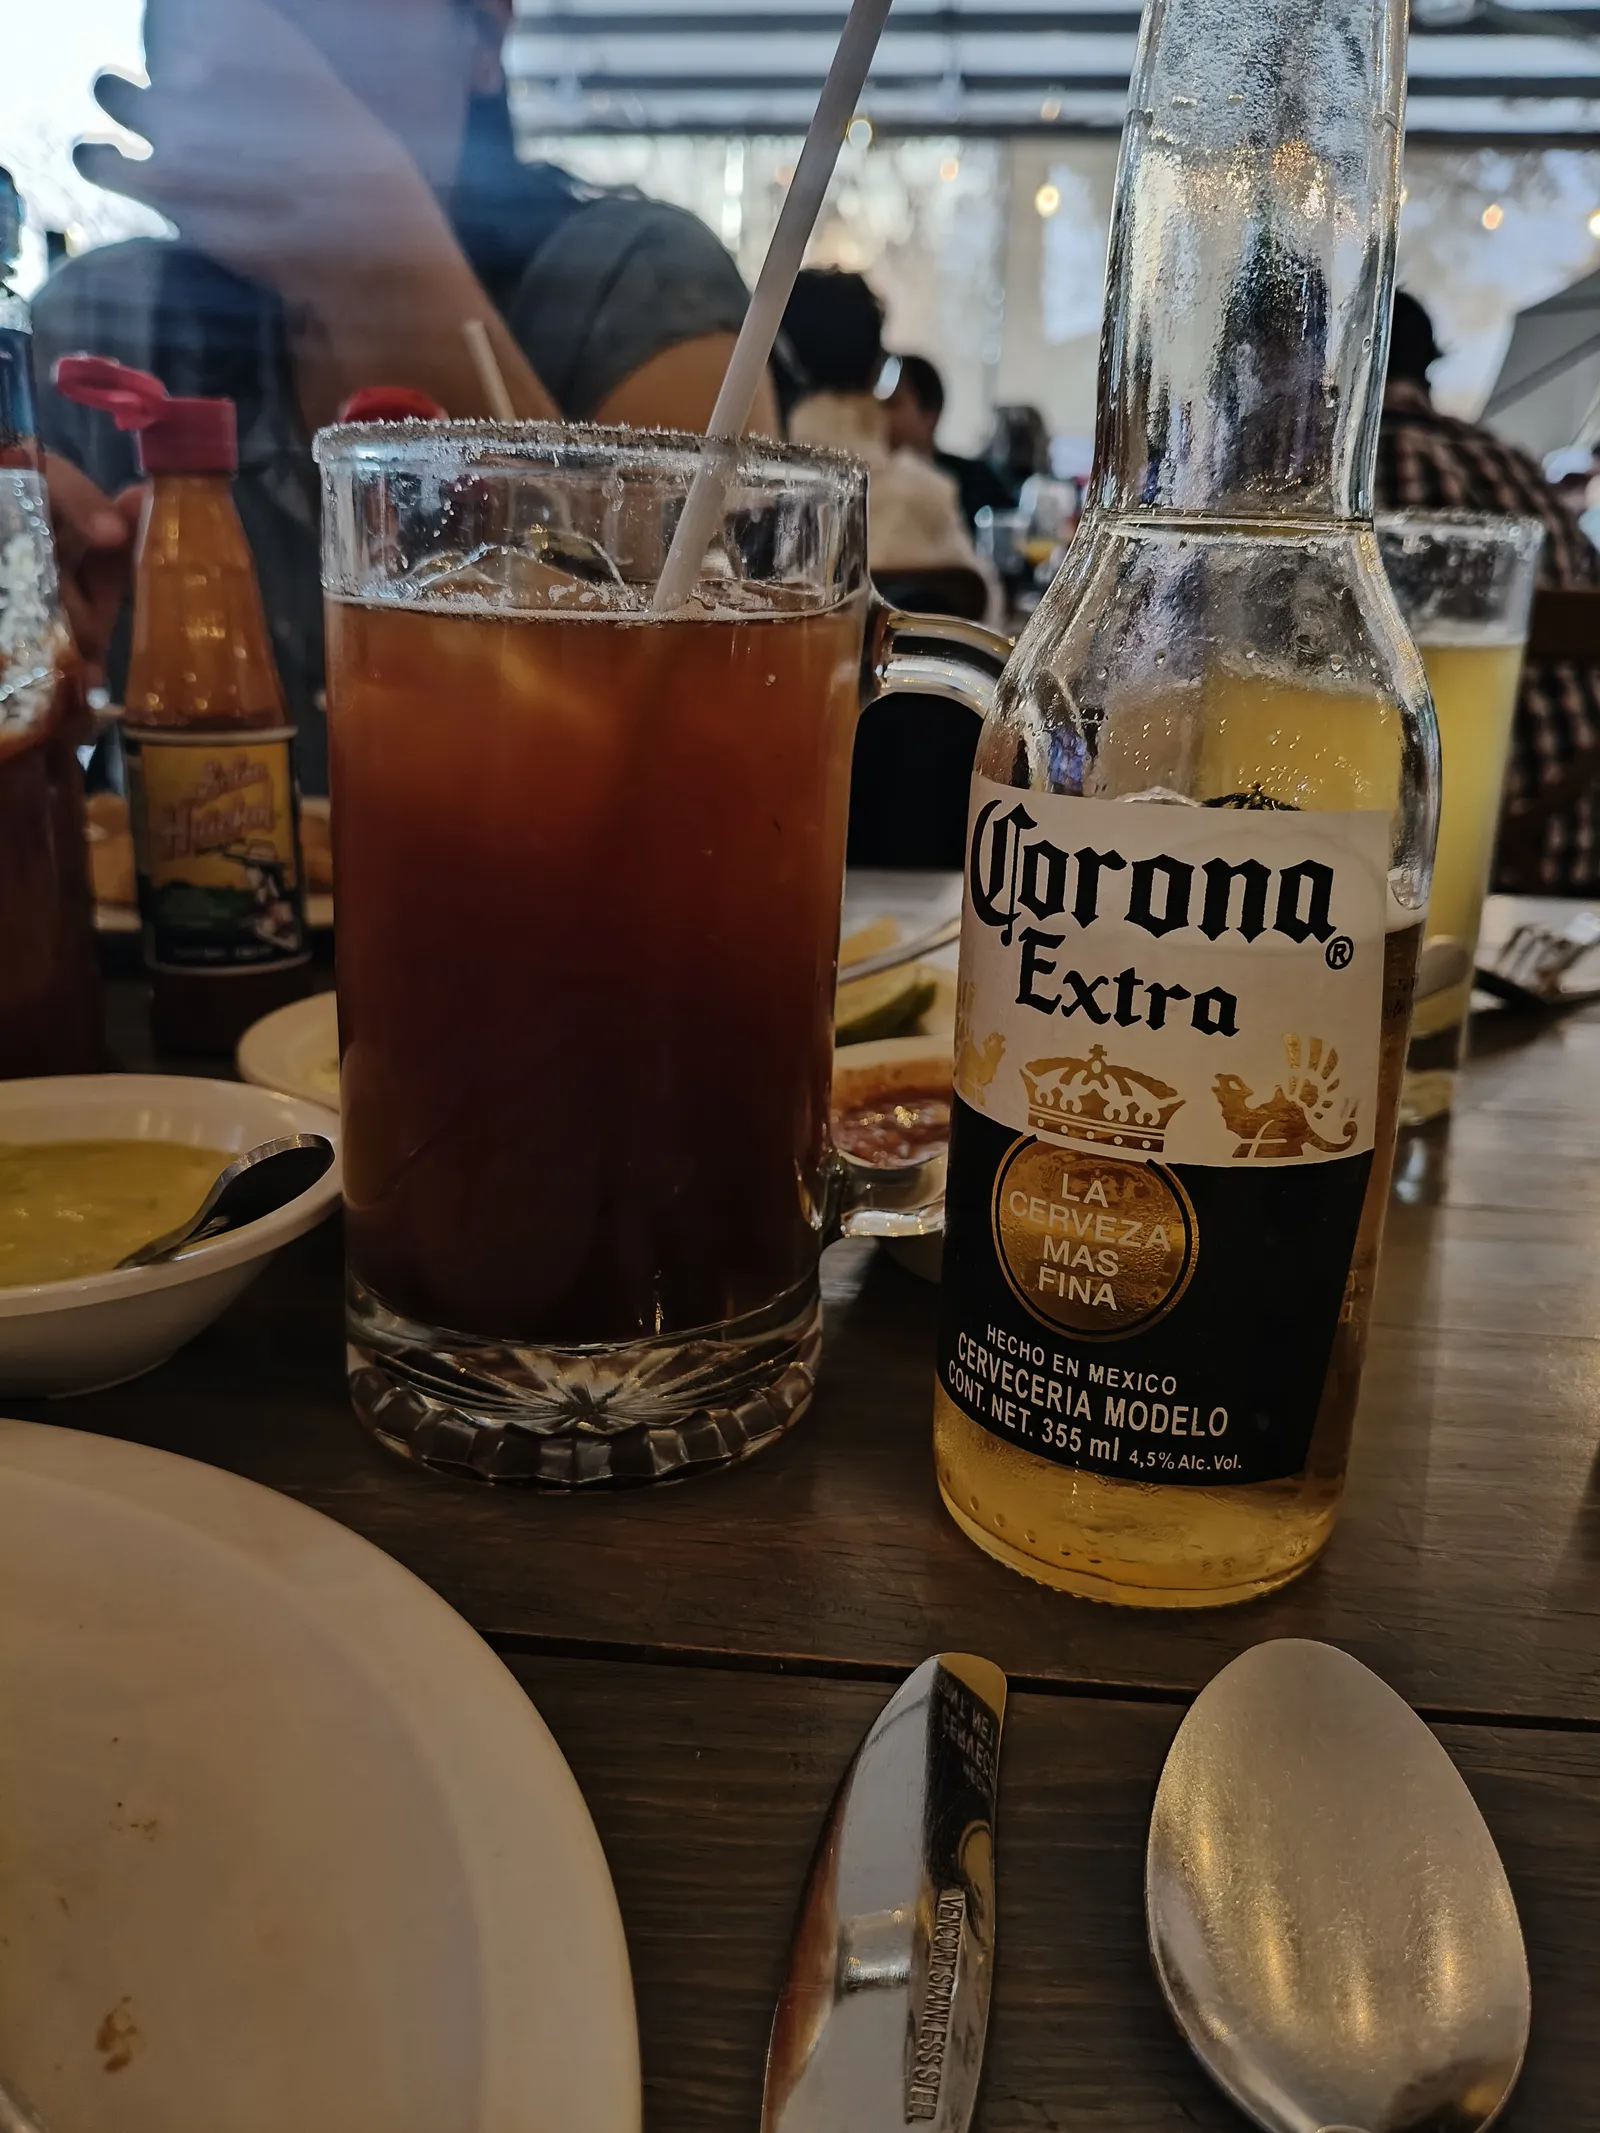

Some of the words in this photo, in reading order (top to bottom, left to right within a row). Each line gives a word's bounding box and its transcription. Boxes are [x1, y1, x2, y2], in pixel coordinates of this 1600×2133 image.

[970, 800, 1337, 946] Corona
[1015, 927, 1240, 1037] Extra
[1009, 1190, 1172, 1252] CERVEZA
[1061, 1173, 1109, 1208] LA
[1038, 1265, 1118, 1311] FINA
[1043, 1234, 1120, 1277] MAS
[958, 1331, 1092, 1421] CERVECERIA
[1104, 1396, 1229, 1437] MODELO
[986, 1323, 1045, 1366] HECHO
[1052, 1353, 1079, 1378] EN
[1088, 1363, 1177, 1396] MEXICO
[948, 1359, 986, 1412] CONT.
[991, 1393, 1034, 1437] NET.
[1041, 1417, 1082, 1453] 355
[1089, 1437, 1120, 1462] ml
